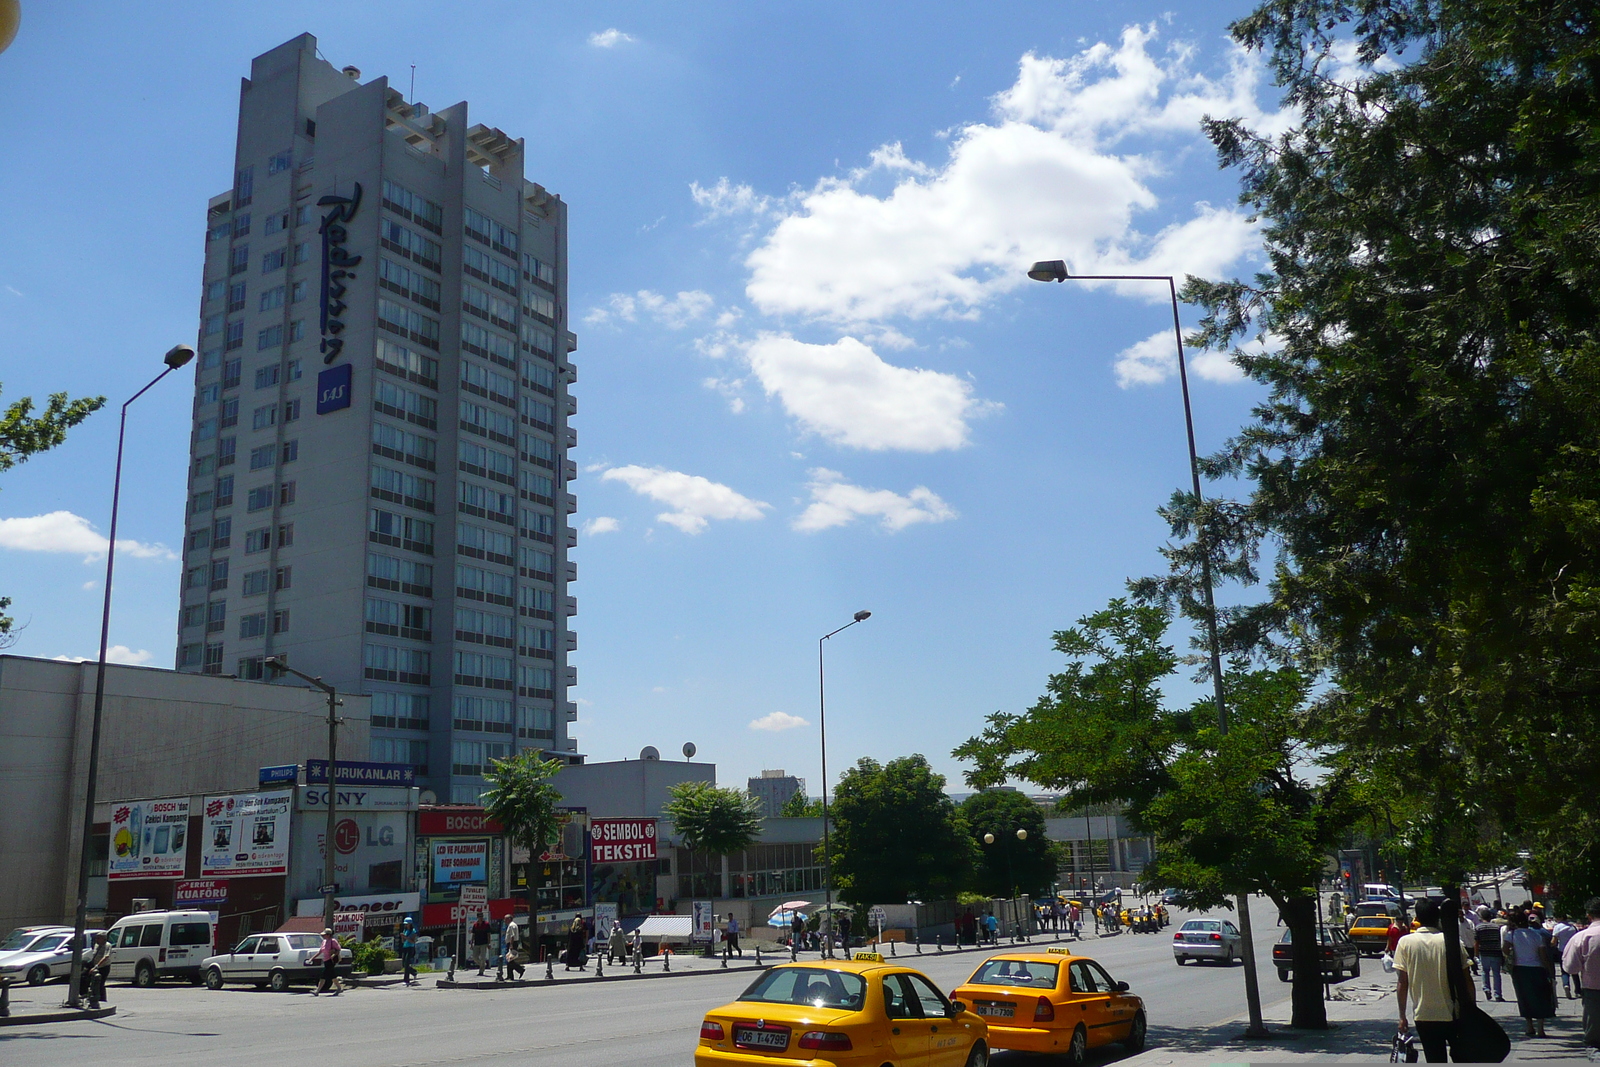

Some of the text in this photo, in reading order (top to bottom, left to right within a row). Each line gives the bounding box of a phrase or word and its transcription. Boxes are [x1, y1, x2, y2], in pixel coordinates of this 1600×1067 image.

[316, 181, 362, 365] Radisson
[319, 385, 345, 404] SAS
[271, 768, 294, 778] PHILIPS
[264, 796, 290, 806] Kampanya
[154, 802, 176, 813] BOSCH
[162, 813, 188, 824] Kampanya
[446, 816, 487, 830] BOSCH
[366, 825, 394, 847] LG
[603, 822, 644, 841] SEMBOL
[436, 845, 447, 855] LCD
[447, 844, 454, 855] VE
[453, 857, 481, 867] SORMADAN
[190, 881, 215, 889] ERKEK
[177, 886, 228, 900] KUAFÖRÜ
[333, 900, 404, 913] Pioneer
[451, 903, 489, 920] BOSCH
[332, 913, 350, 924] SICAK
[334, 923, 360, 933] EMANET
[980, 1006, 988, 1015] 06
[990, 1007, 995, 1016] T
[742, 1031, 786, 1046] 06 T 4795
